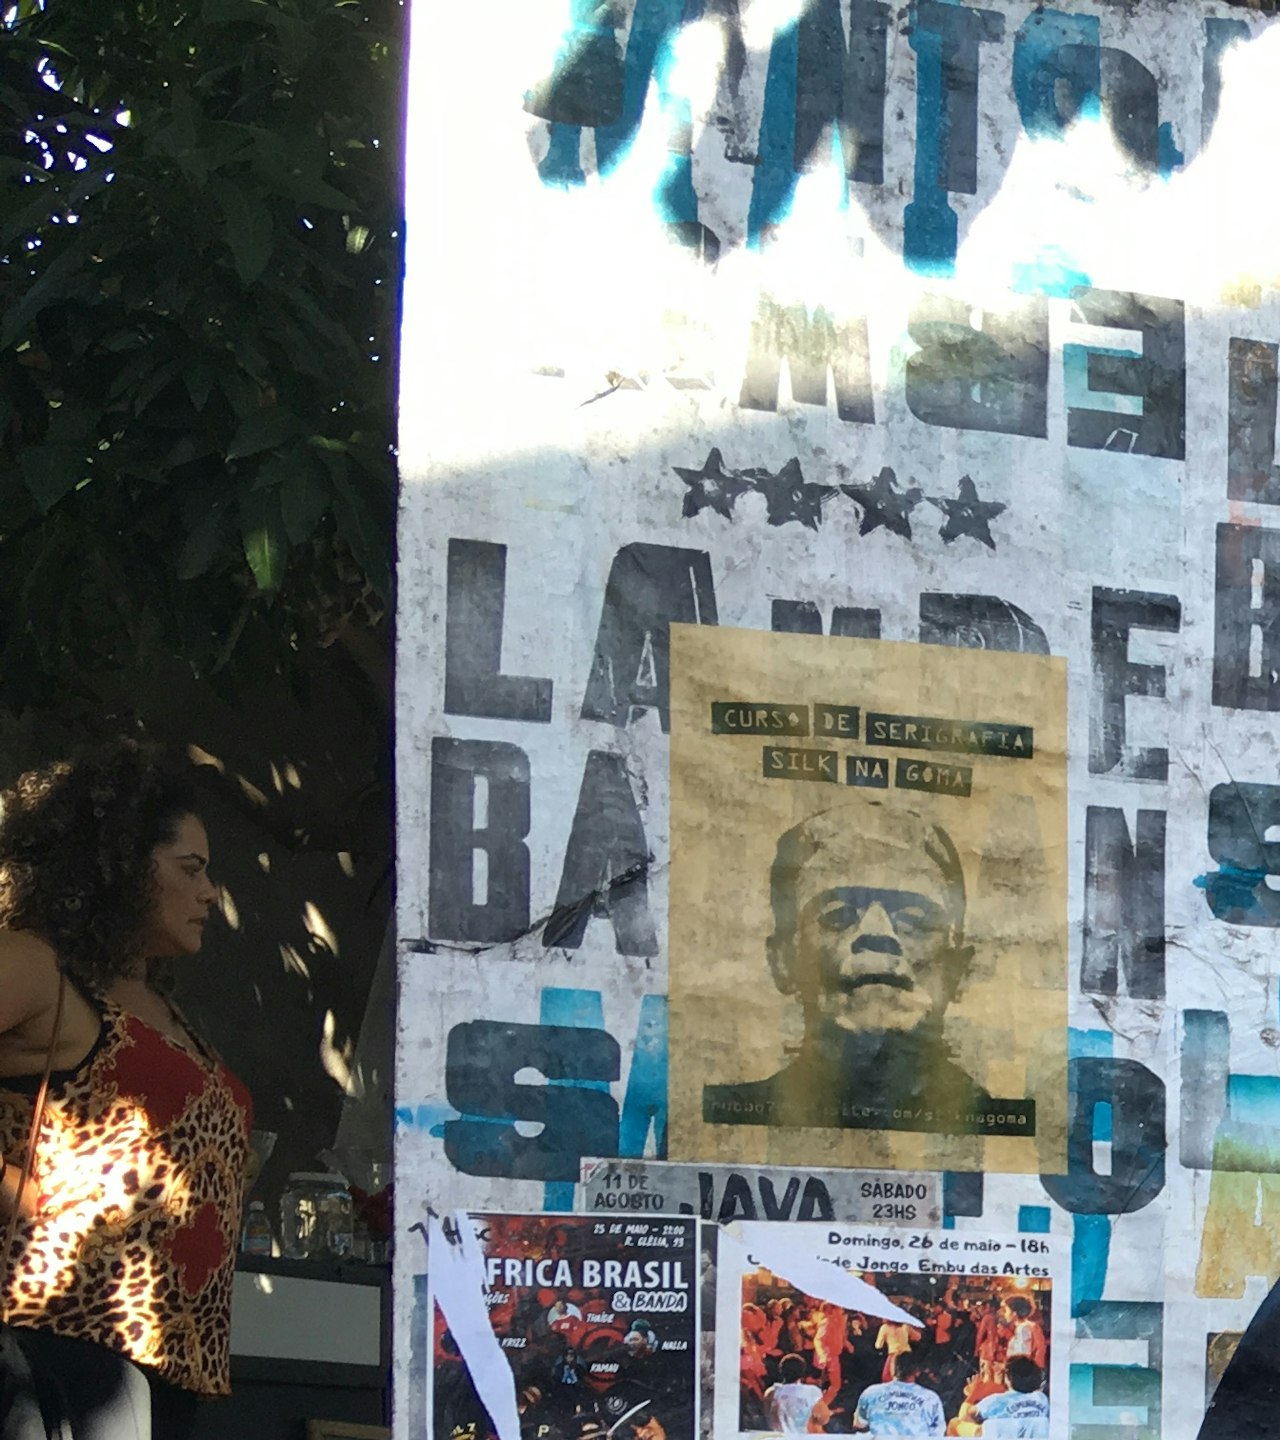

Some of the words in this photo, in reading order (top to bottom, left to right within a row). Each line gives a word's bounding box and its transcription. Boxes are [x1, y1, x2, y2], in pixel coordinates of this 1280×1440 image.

[724, 709, 799, 728] CURSO
[822, 712, 851, 732] DE
[873, 721, 1025, 751] SERIGRAFIA
[770, 751, 832, 773] SILK
[854, 759, 884, 779] NA
[905, 764, 964, 788] GOMA
[628, 1174, 649, 1191] DE
[860, 1178, 928, 1200] SÁBADO
[594, 1191, 664, 1211] AGOSTO
[872, 1204, 917, 1220] 23HS
[608, 1223, 623, 1235] DE
[625, 1224, 650, 1235] MAIO
[828, 1231, 904, 1251] Domingo,
[908, 1234, 934, 1249] 26
[939, 1237, 960, 1251] de
[963, 1237, 1002, 1252] maio
[1020, 1239, 1050, 1254] 18h
[486, 1257, 573, 1288] FRICA
[582, 1258, 689, 1290] BRASIL
[856, 1255, 909, 1273] Jongo
[918, 1258, 966, 1274] Embu
[969, 1260, 999, 1276] das
[1002, 1261, 1050, 1277] Artes
[611, 1291, 631, 1312] &
[632, 1291, 688, 1312] BANDA
